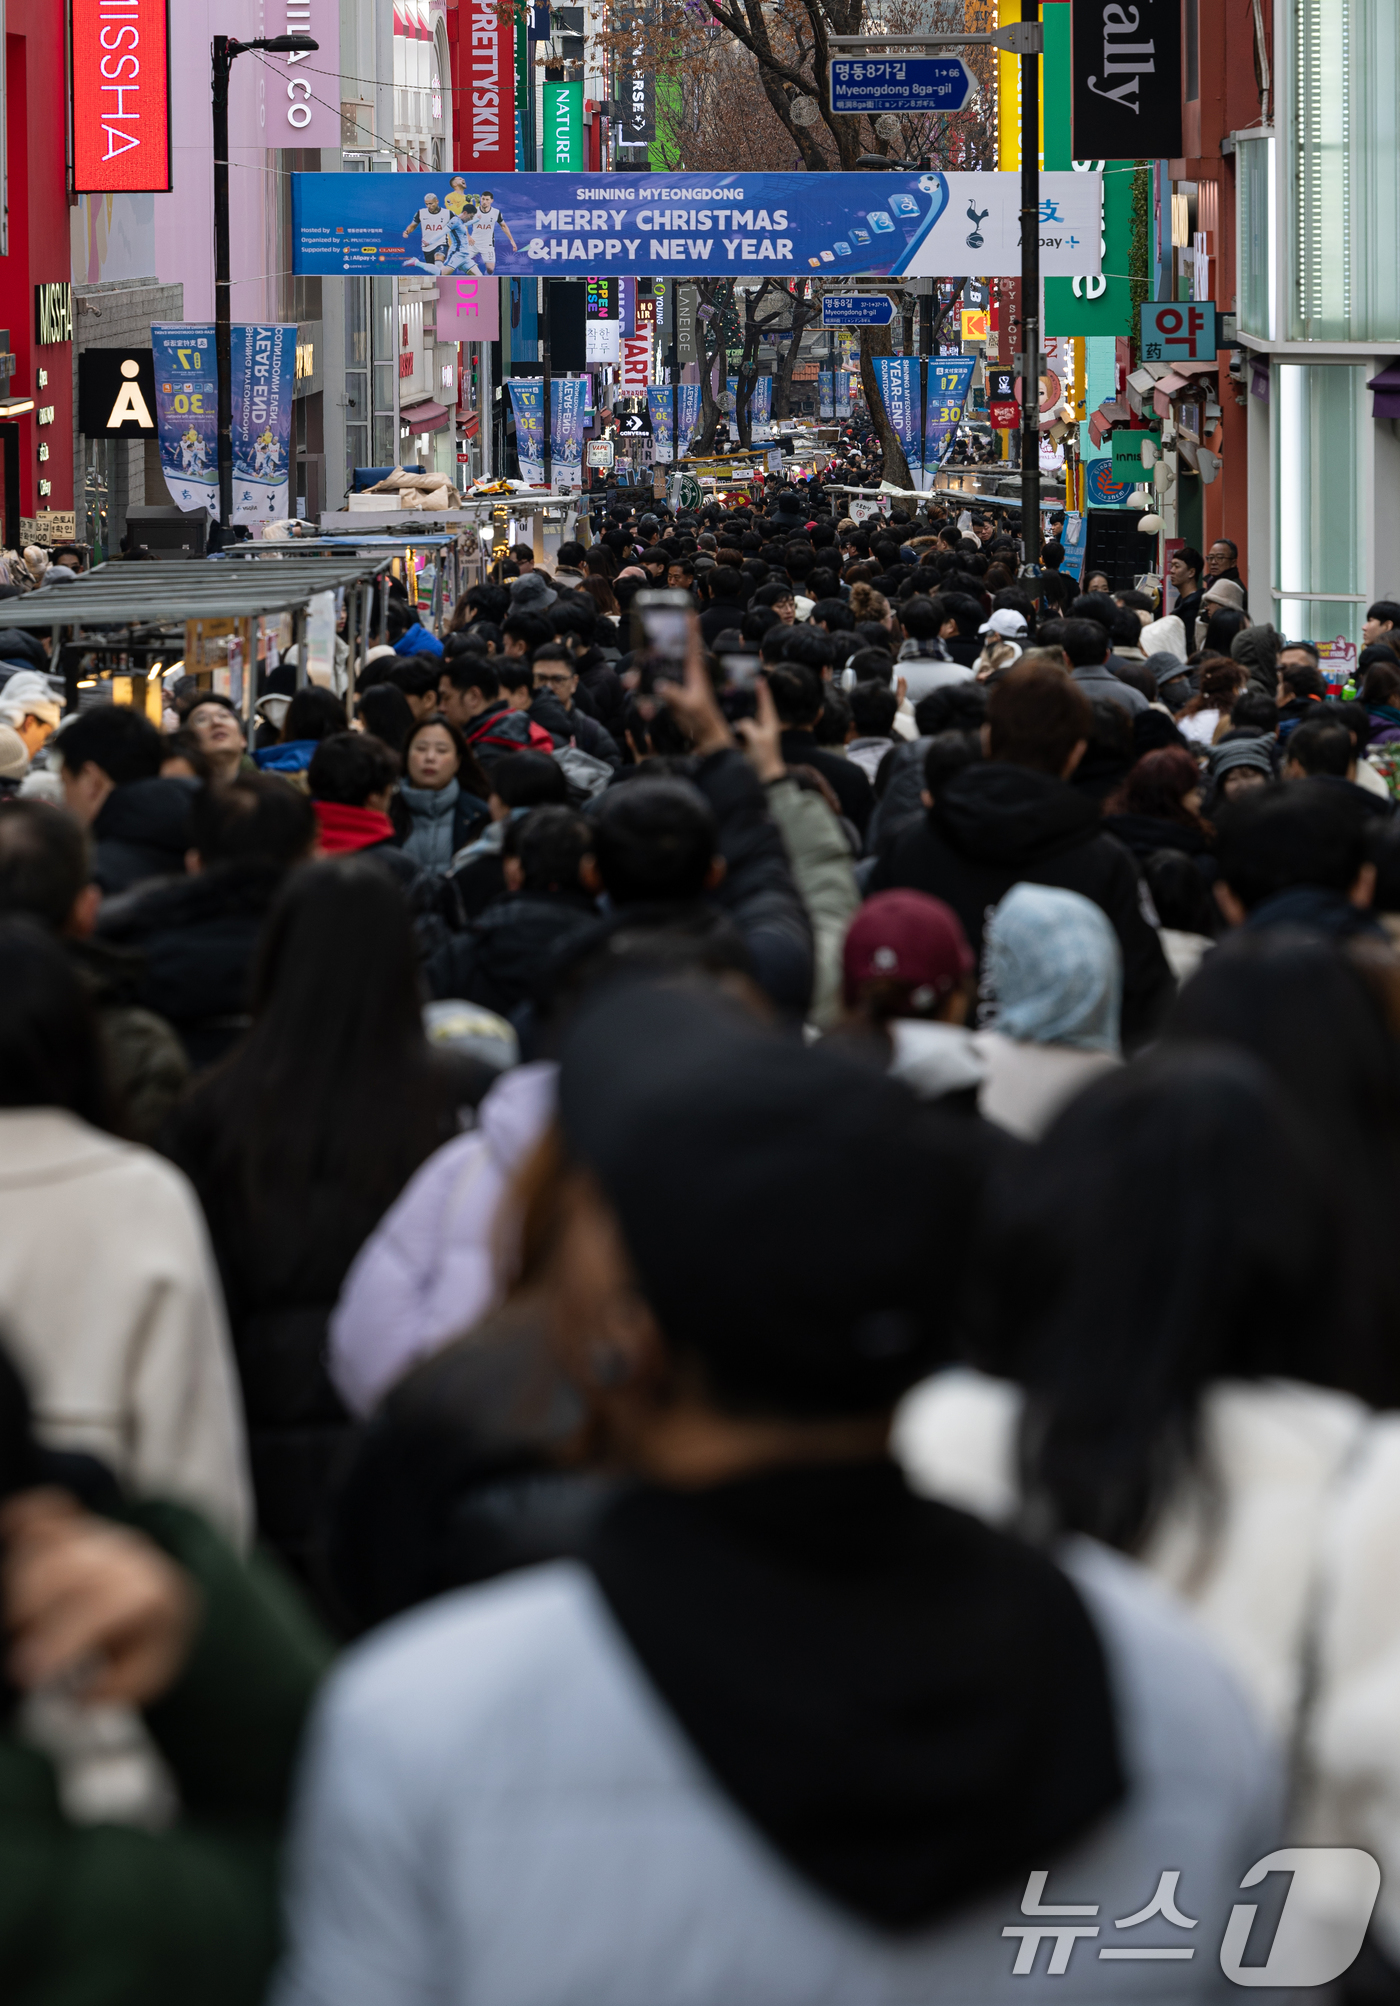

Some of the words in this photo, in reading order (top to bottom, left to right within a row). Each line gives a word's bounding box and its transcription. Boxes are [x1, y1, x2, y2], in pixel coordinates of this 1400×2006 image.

[287, 0, 310, 66] ILA
[1087, 0, 1156, 115] ally
[835, 63, 906, 81] 명동8가길
[836, 84, 909, 97] Myeongdong
[912, 83, 952, 96] 8ga-gil
[287, 78, 312, 128] CO
[556, 90, 570, 163] NATURE
[576, 188, 635, 200] SHINING
[638, 188, 744, 200] MYEONGDONG
[535, 210, 628, 231] MERRY
[635, 209, 788, 231] CHRISTMAS
[527, 238, 641, 260] &HAPPY
[650, 239, 714, 260] NEW
[722, 239, 794, 260] YEAR
[40, 282, 74, 346] MISSHA
[656, 296, 664, 325] YOUNG
[825, 298, 853, 309] 명동8길
[825, 309, 862, 317] Myeongdong
[1155, 306, 1205, 358] 약
[1145, 342, 1162, 360] 药
[880, 359, 889, 407] COUNTDOWN
[902, 359, 910, 389] SHINING
[947, 374, 959, 389] 7
[889, 359, 904, 430] YEAR-END
[903, 389, 911, 442] MYEONGDONG
[939, 407, 962, 423] 30
[1116, 452, 1142, 461] innis
